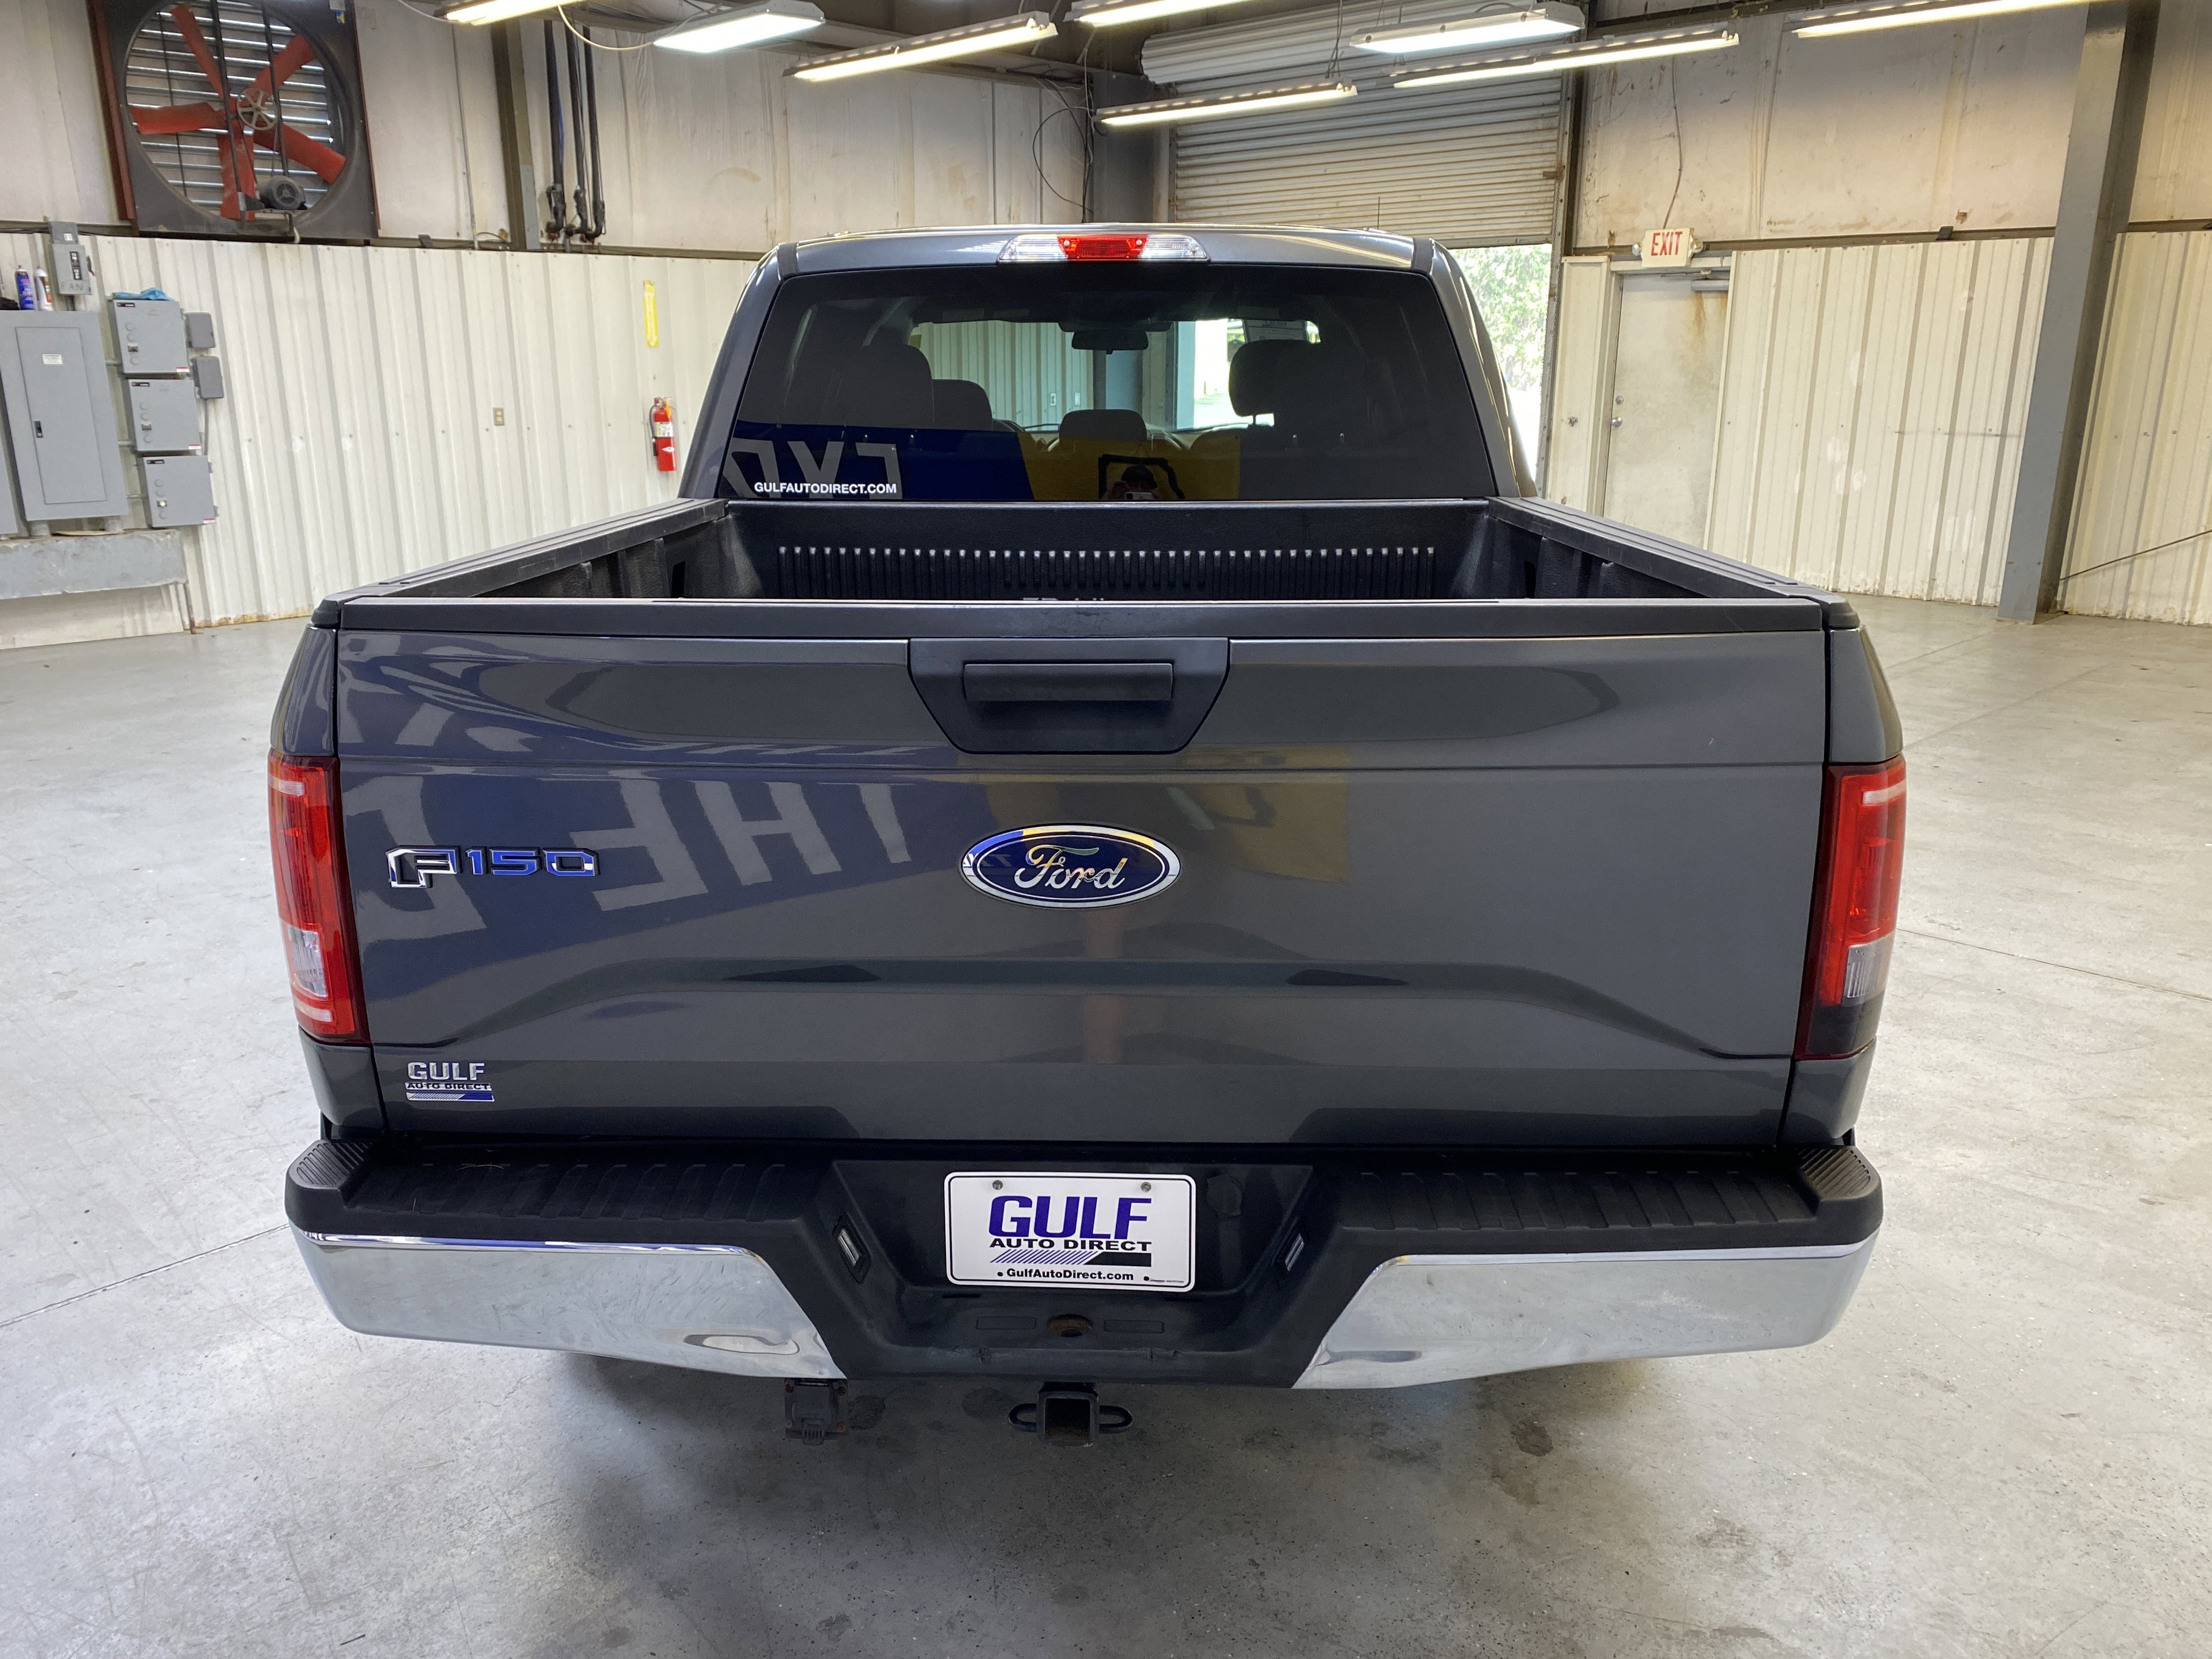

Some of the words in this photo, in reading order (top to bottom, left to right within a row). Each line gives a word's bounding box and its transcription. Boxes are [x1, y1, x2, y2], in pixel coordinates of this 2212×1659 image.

[1651, 231, 1683, 256] EXIT
[60, 281, 83, 291] FAN
[754, 482, 897, 494] GULFAUTODIRECT.COM
[1013, 844, 1128, 889] Ford
[407, 1062, 485, 1081] GULF
[989, 1195, 1152, 1240] GULF
[989, 1238, 1055, 1249] AUTO
[1063, 1239, 1152, 1251] DIRECT
[1006, 1268, 1135, 1281] GulfAutoDirect.com
